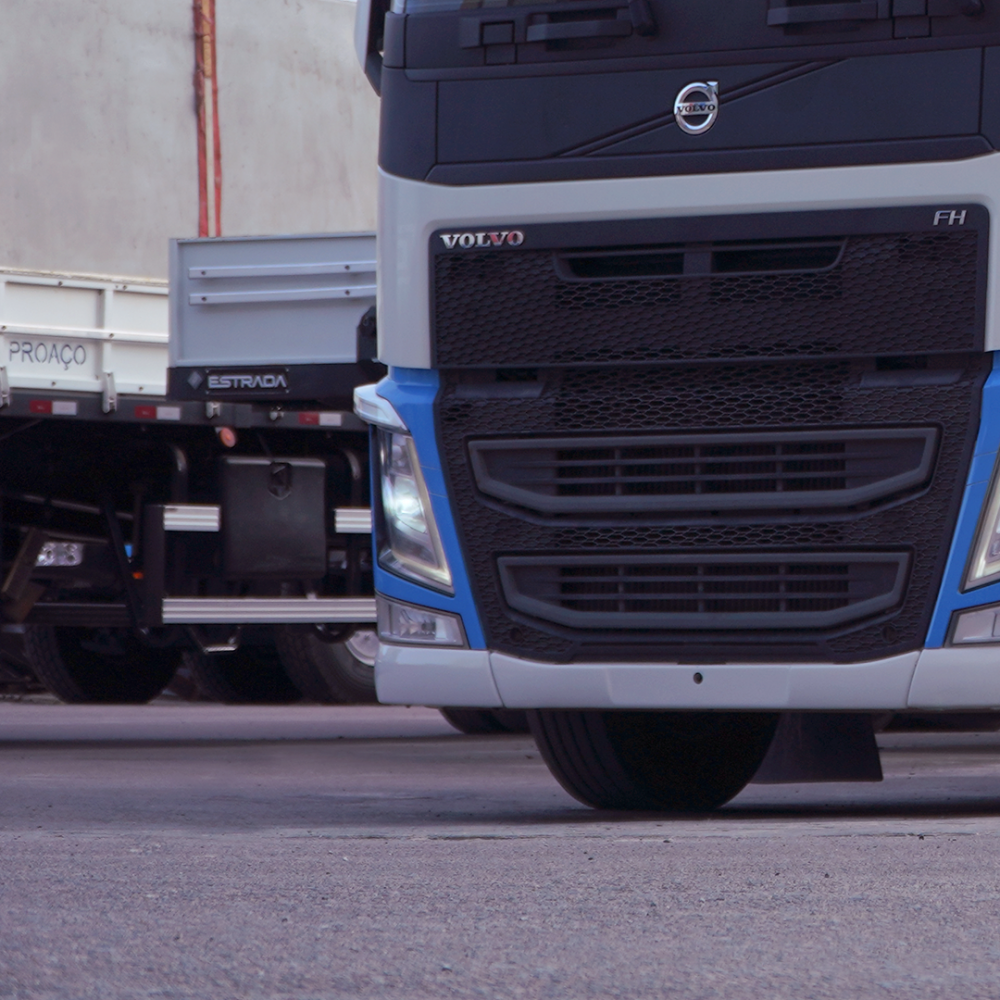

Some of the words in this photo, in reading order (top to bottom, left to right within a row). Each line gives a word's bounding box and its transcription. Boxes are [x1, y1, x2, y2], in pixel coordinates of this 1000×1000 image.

[676, 102, 716, 112] VOLVO
[933, 210, 967, 226] FH
[440, 230, 525, 250] VOLVO
[9, 341, 87, 371] PROAÇO
[208, 374, 287, 389] ESTRADA
